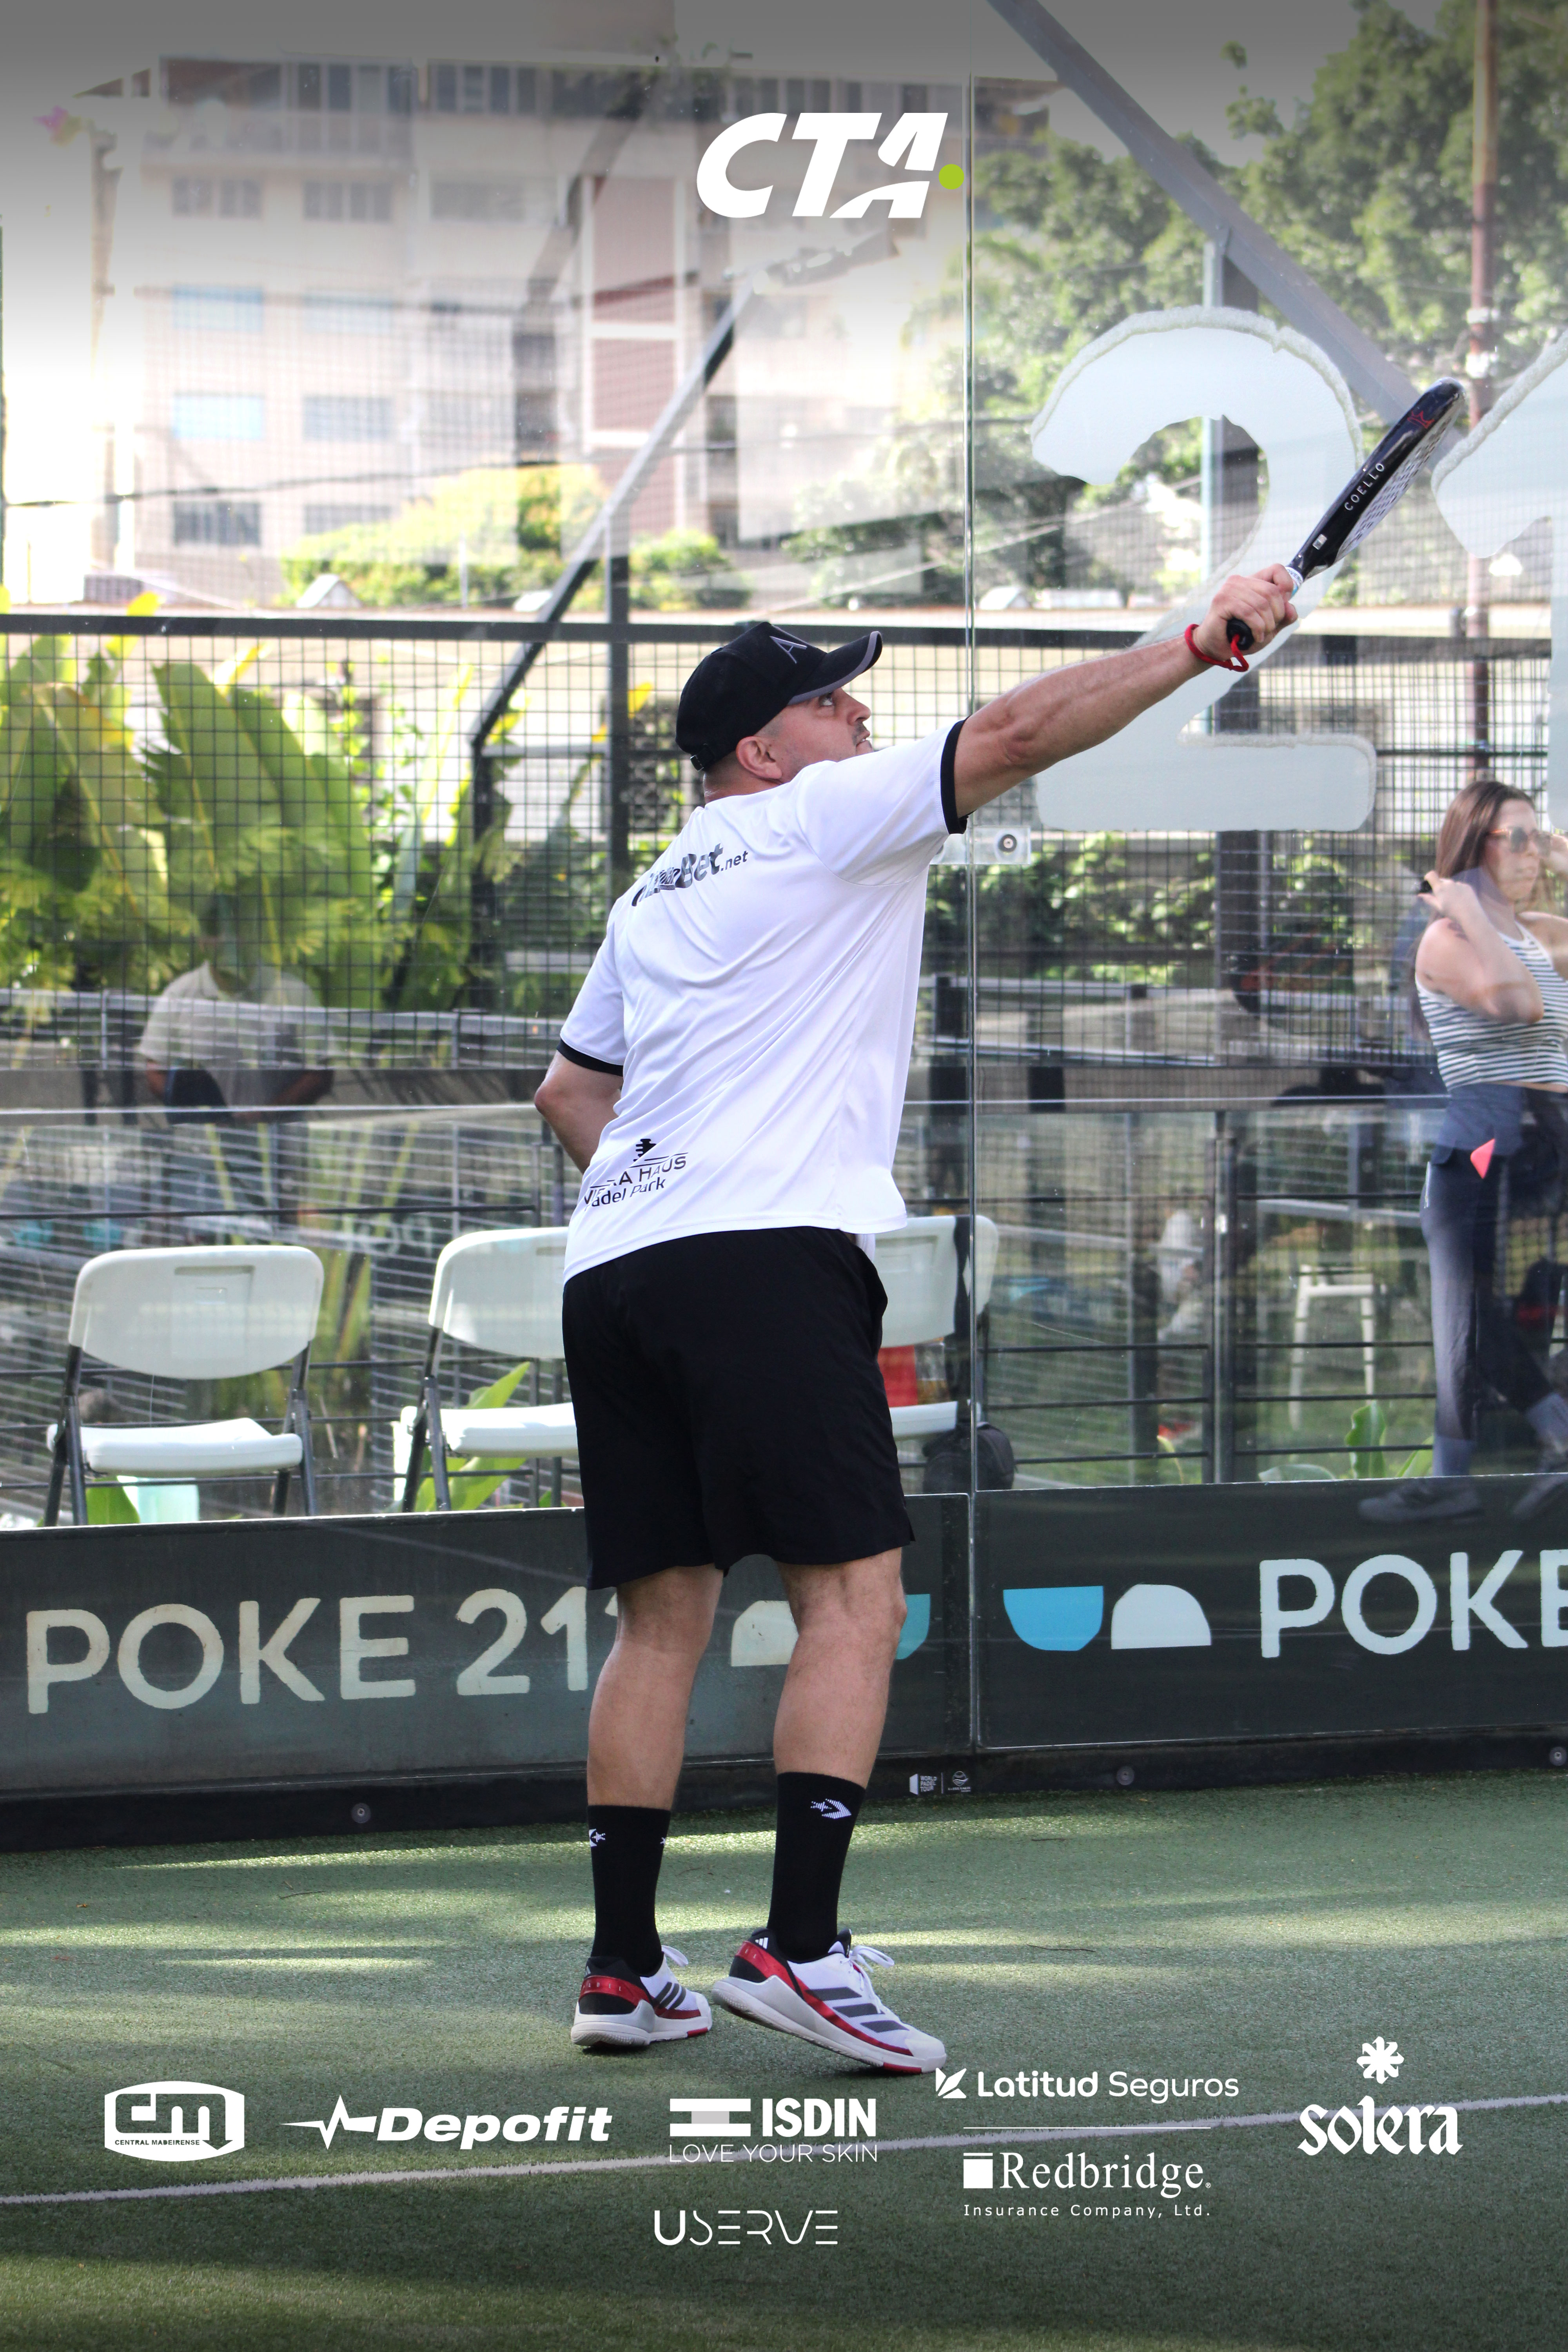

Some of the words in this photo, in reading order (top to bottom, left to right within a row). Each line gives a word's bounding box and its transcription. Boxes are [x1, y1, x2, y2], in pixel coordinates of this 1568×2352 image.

[1345, 463, 1384, 510] COELLO
[630, 1177, 666, 1197] Park
[639, 1156, 686, 1182] HAUS
[27, 1595, 417, 1714] POKE
[455, 1586, 618, 1696] 21
